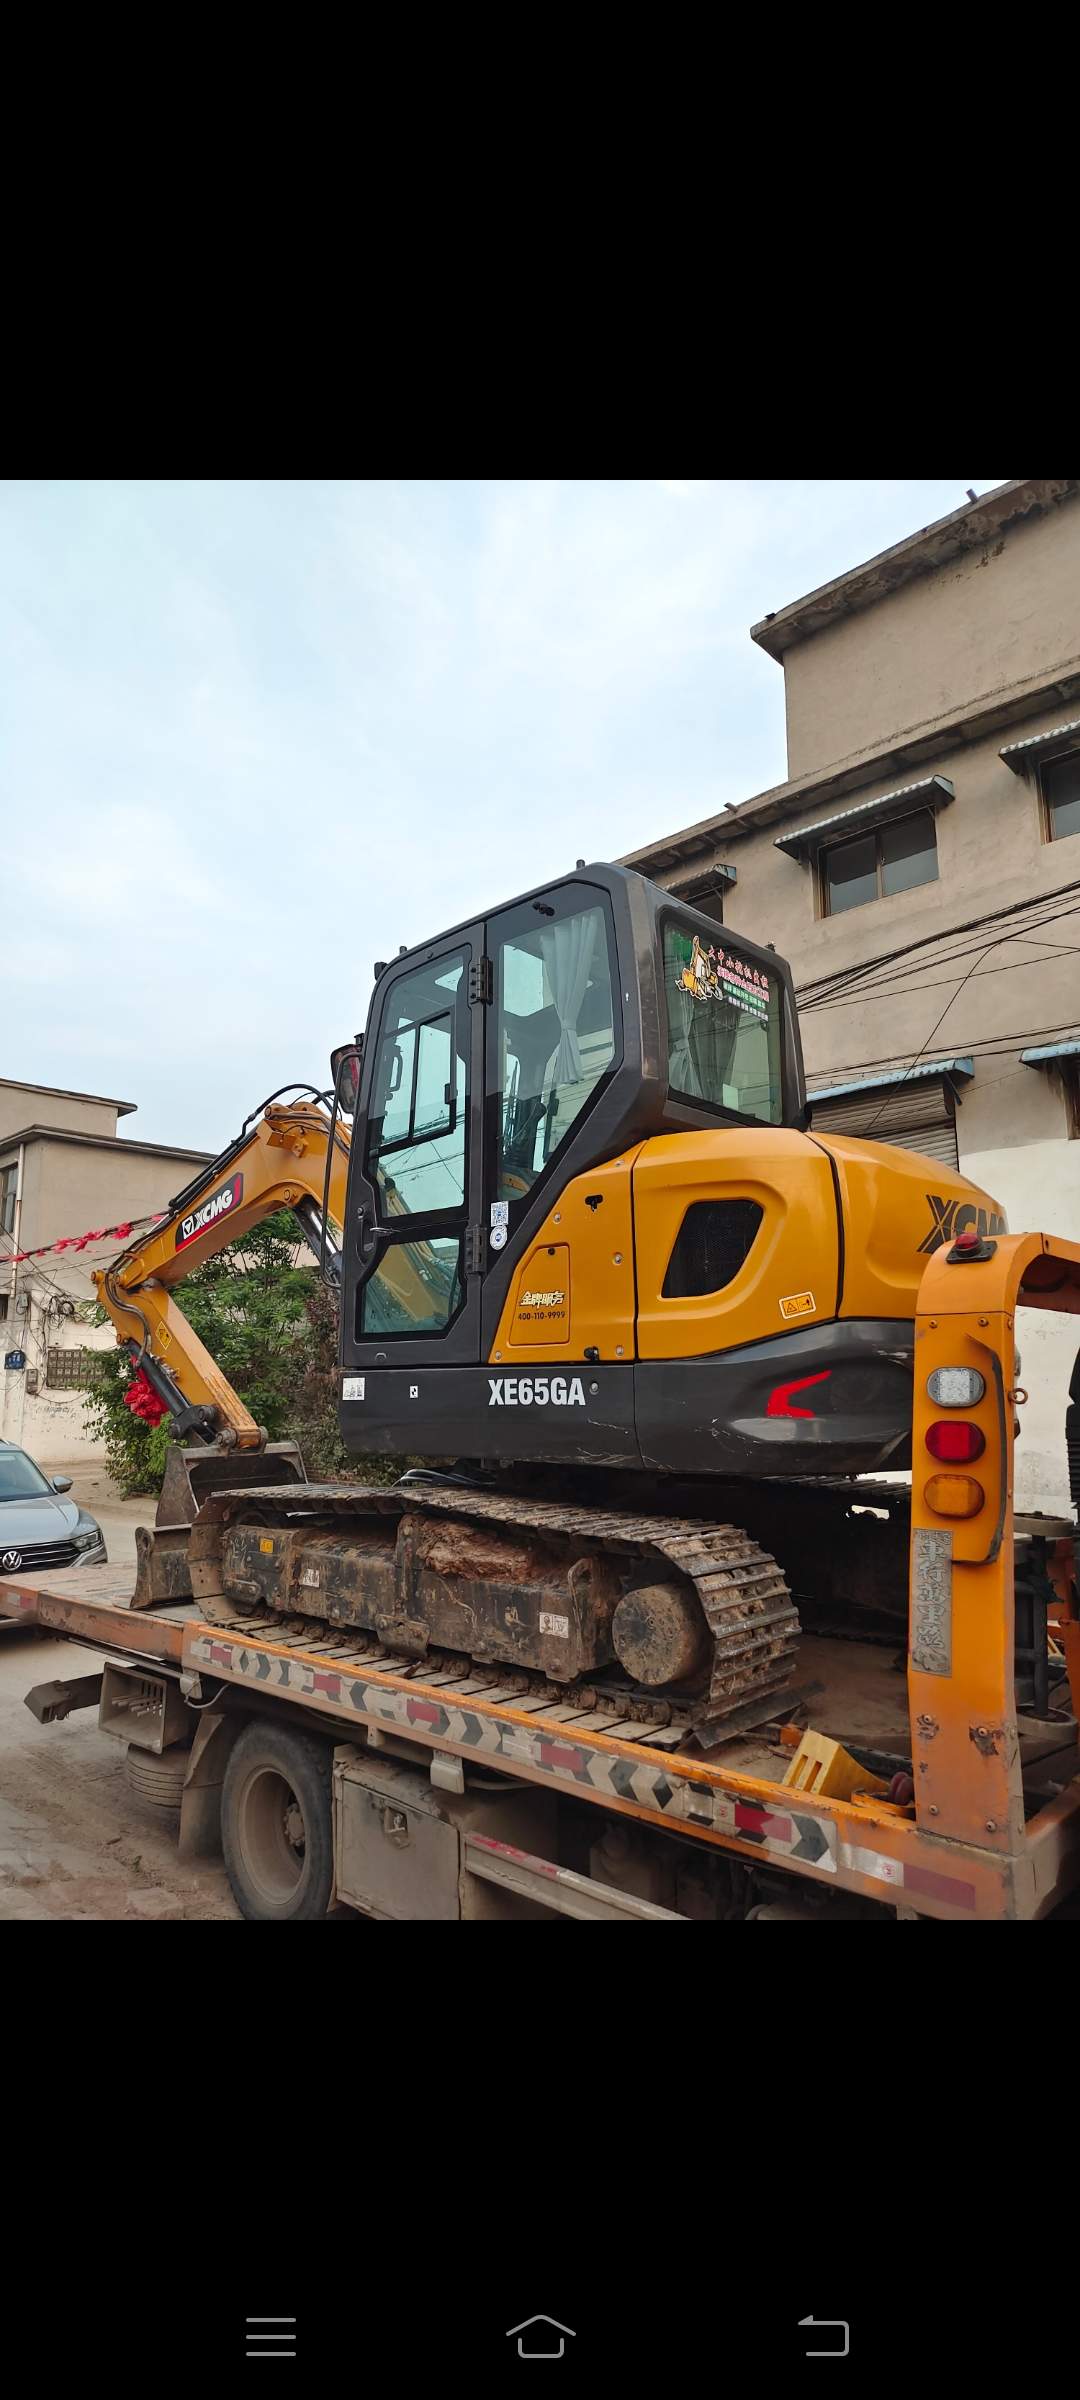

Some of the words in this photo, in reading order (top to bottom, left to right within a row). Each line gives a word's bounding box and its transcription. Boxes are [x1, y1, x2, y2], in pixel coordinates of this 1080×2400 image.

[194, 1189, 233, 1231] XCMG
[520, 1291, 565, 1309] 金牌服务
[518, 1311, 566, 1321] 400-110-9999
[488, 1377, 586, 1406] XE65GA
